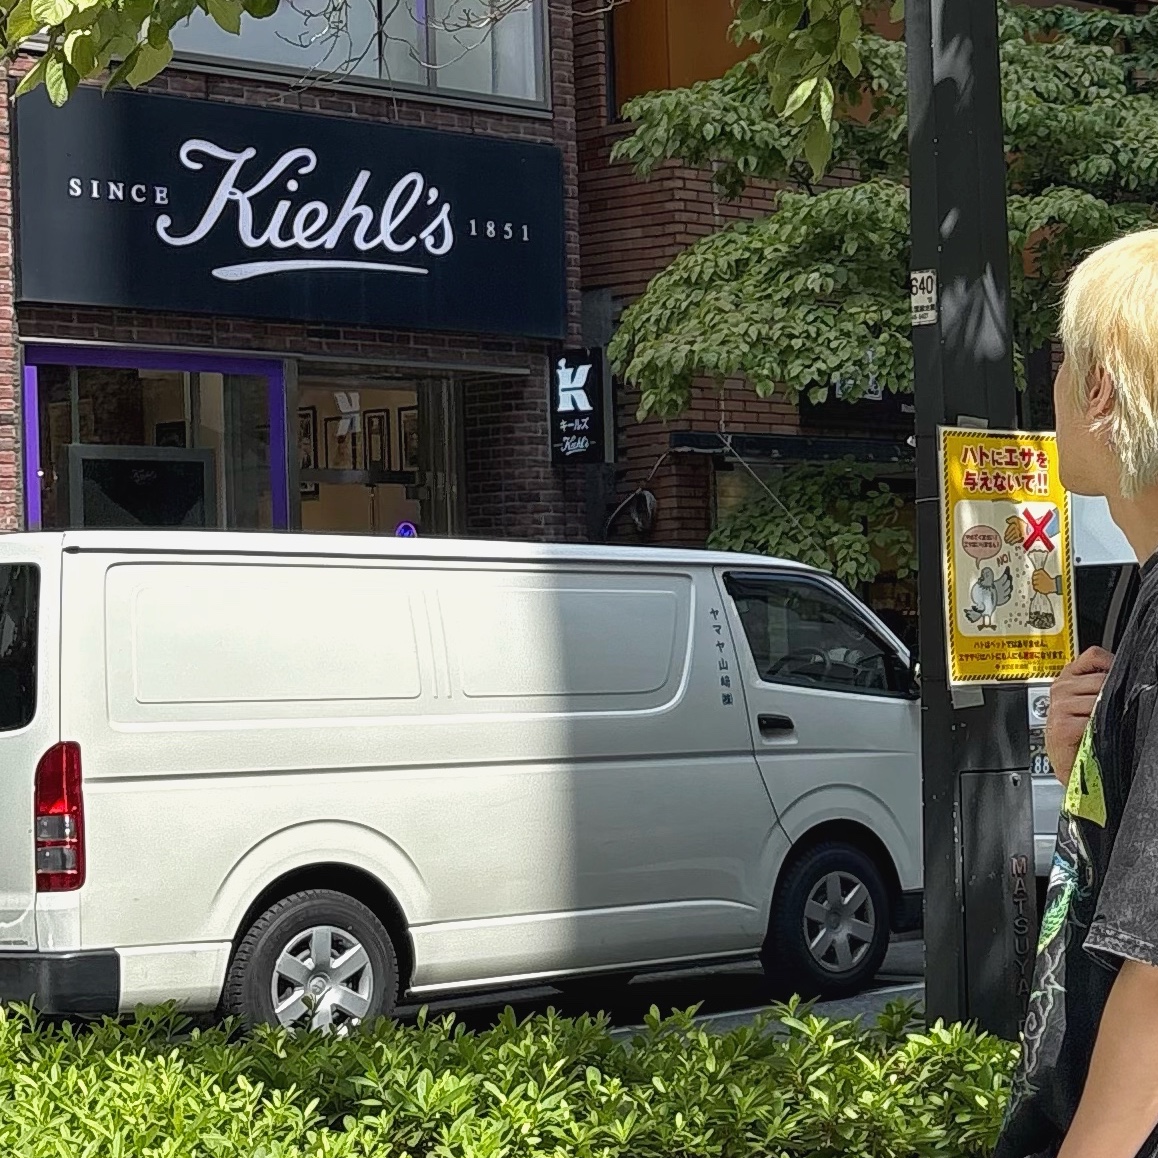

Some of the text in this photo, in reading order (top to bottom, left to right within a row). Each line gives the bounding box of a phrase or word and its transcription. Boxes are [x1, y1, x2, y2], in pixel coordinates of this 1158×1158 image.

[68, 138, 532, 256] SINCE Kiehl's 1851
[911, 275, 934, 296] 640
[961, 445, 1048, 469] ハトにエサを
[963, 471, 1048, 494] 与えないで!!
[997, 550, 1012, 568] NO!
